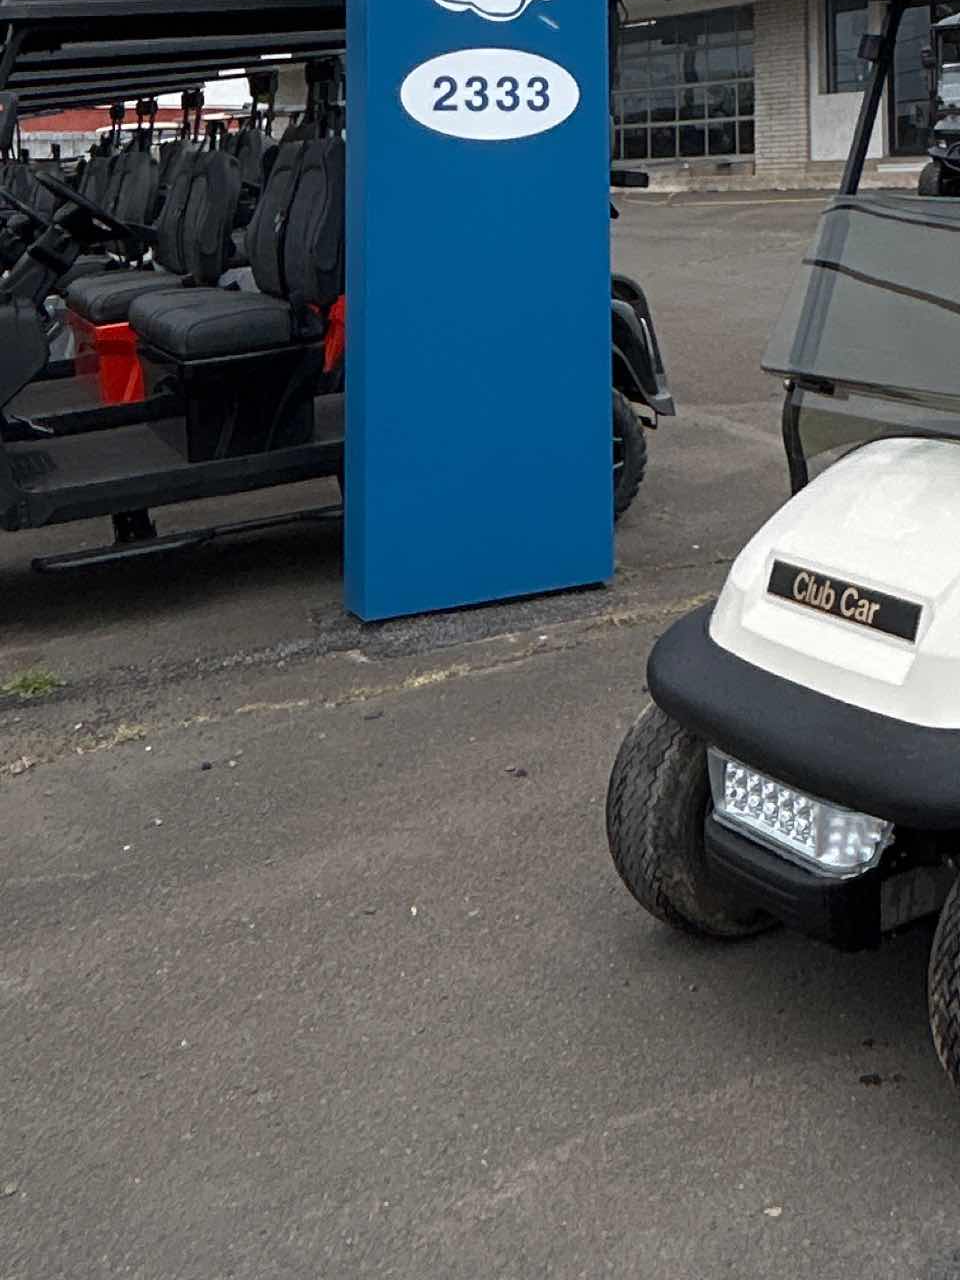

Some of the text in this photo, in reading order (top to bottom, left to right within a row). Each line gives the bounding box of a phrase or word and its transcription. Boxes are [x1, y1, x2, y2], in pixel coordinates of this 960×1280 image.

[432, 75, 550, 112] 2333
[792, 571, 880, 624] Club Car
